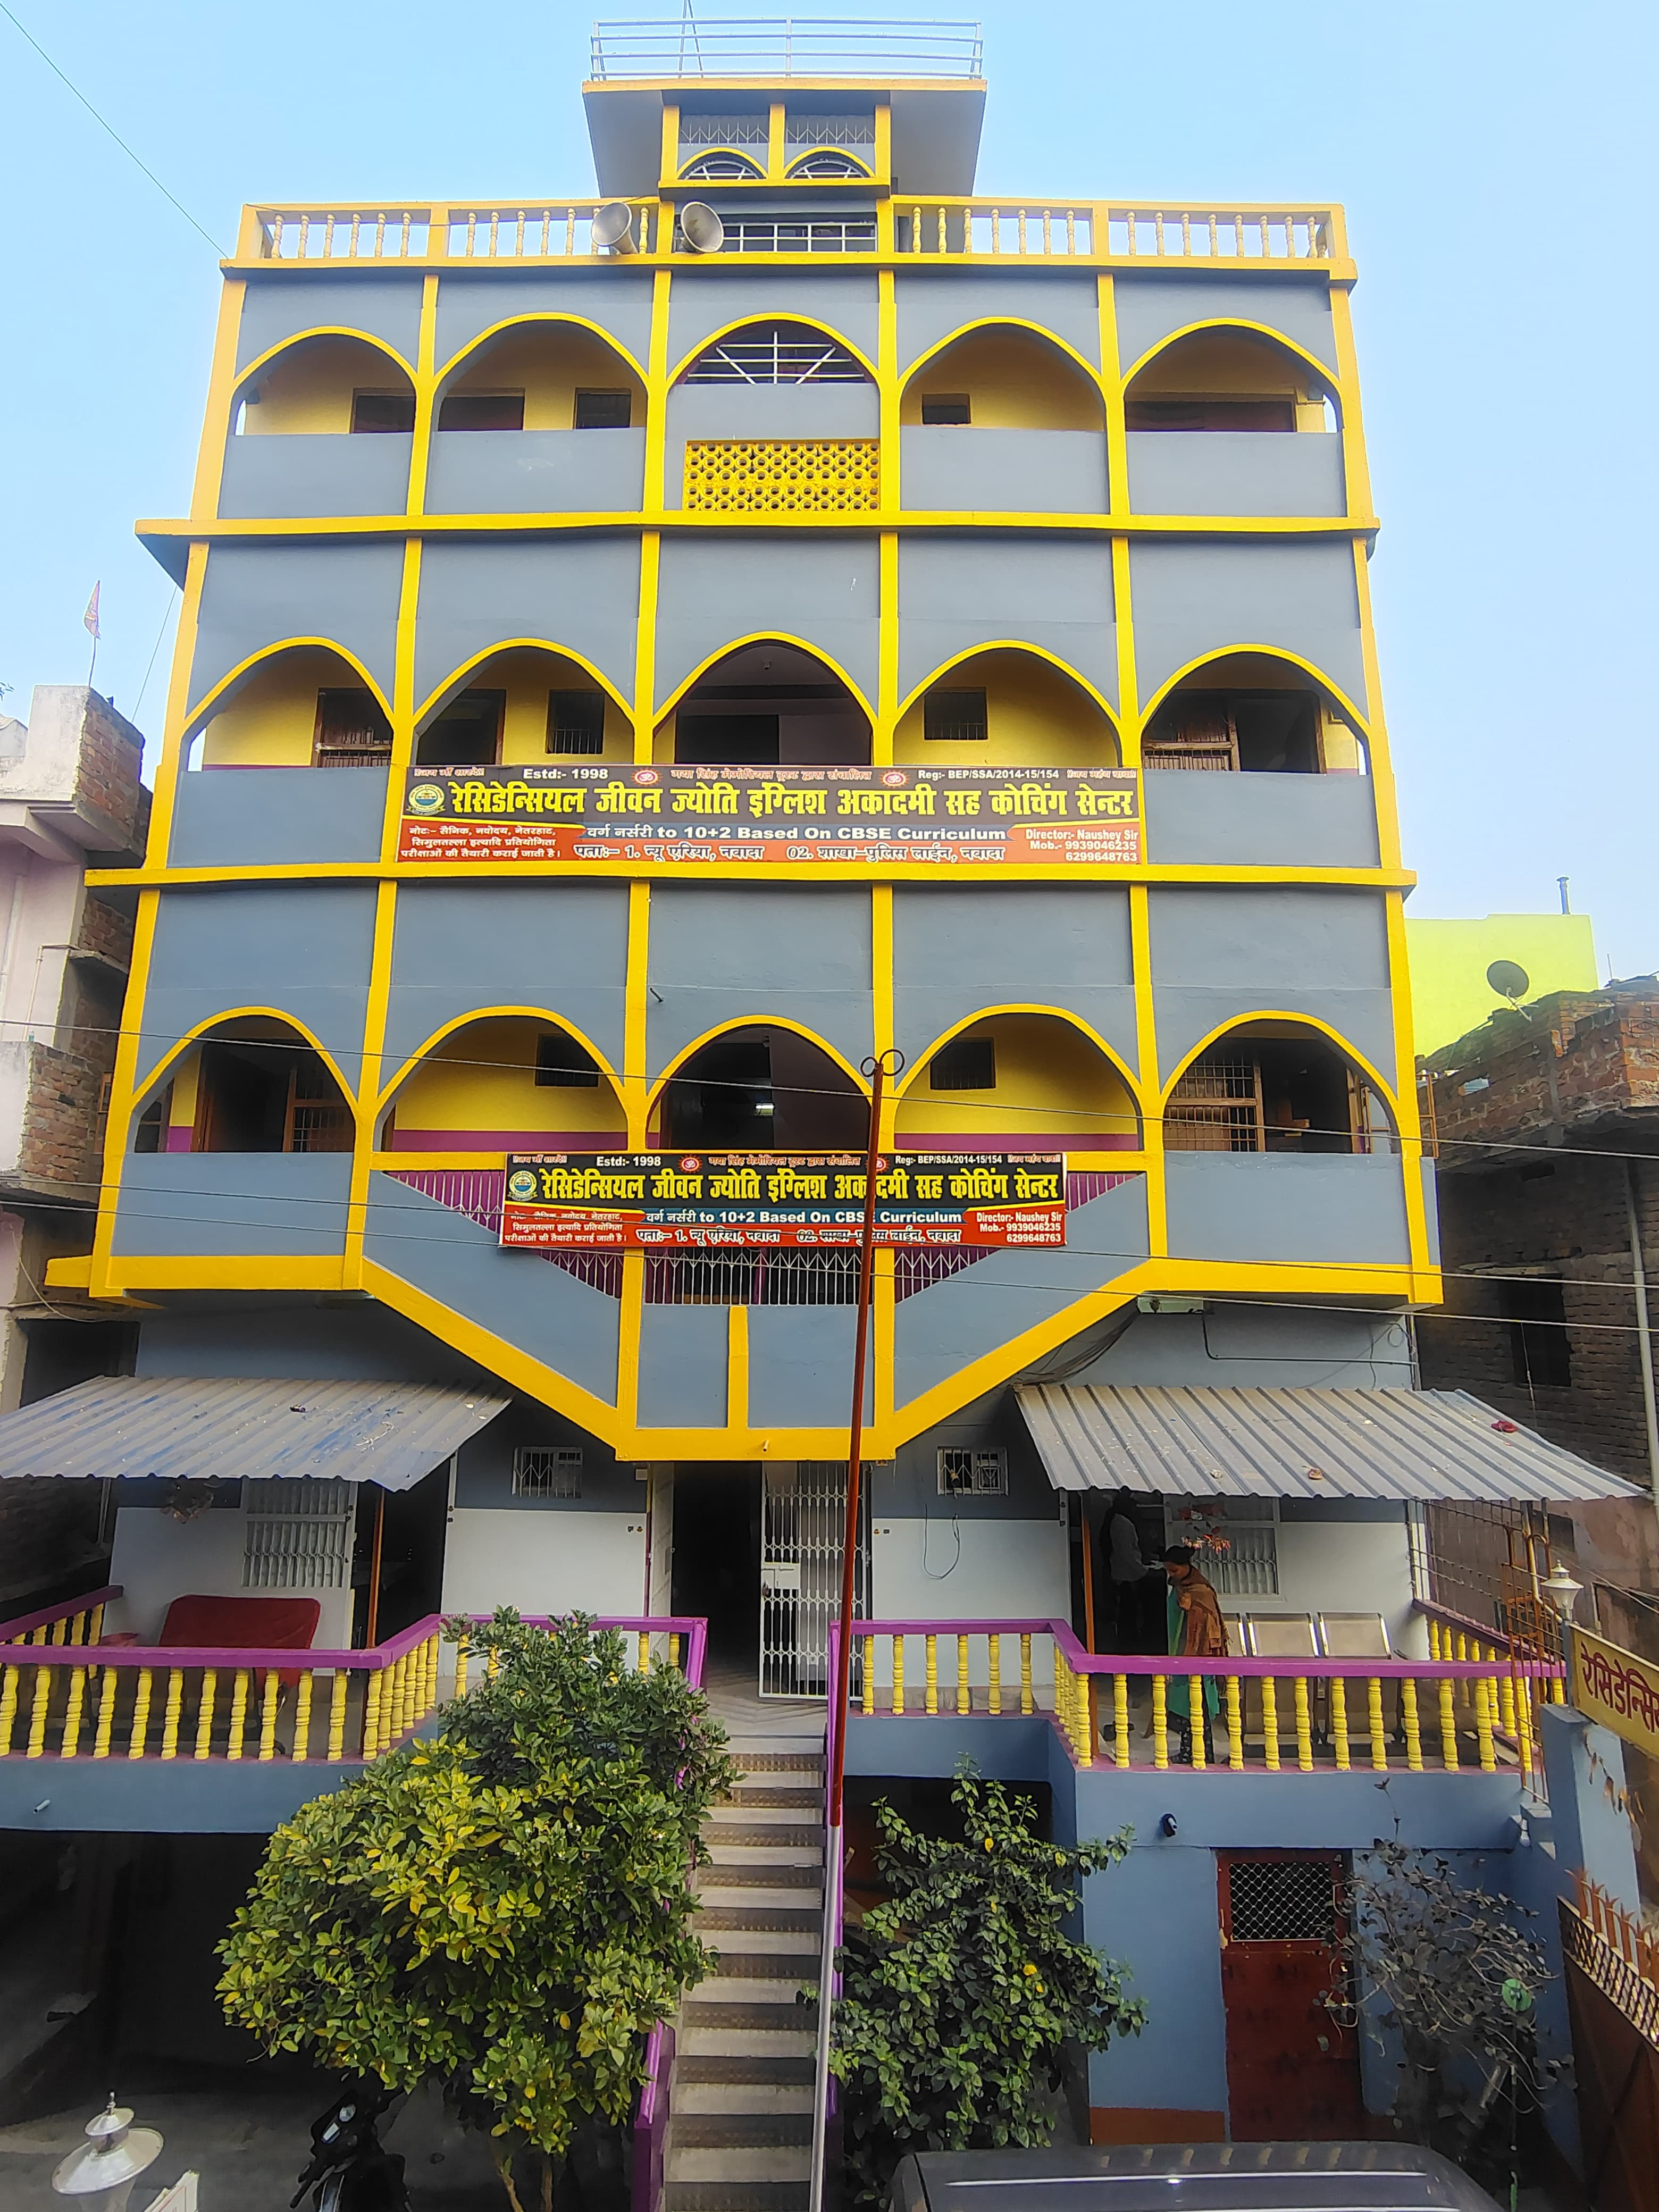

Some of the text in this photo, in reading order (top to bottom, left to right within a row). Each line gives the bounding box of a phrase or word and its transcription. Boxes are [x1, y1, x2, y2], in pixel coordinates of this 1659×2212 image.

[523, 768, 608, 780] Estd:- 1998
[696, 768, 719, 780] सिंह
[720, 768, 774, 780] मेमोरियल
[801, 770, 825, 781] द्वारा
[827, 768, 872, 780] संचालित
[918, 769, 1059, 781] Reg:- BEP/SSA/2014-15/154
[447, 781, 587, 813] रेसिडेन्सियल
[594, 781, 663, 814] जीवन
[670, 782, 740, 814] ज्योति
[837, 783, 937, 815] अकादमी
[944, 790, 982, 816] सह
[988, 782, 1067, 816] कोचिंग
[1075, 783, 1134, 816] सेन्टर
[440, 825, 472, 835] सैनिक,
[475, 825, 511, 835] नवोदय,
[515, 826, 556, 836] नेतरहाट,
[587, 824, 1006, 840] वर्ग नर्सरी to 10+2 Based On CBSE Curriculum
[1026, 829, 1138, 844] Director:- Naushey Sir
[411, 836, 556, 848] सिमुलतल्ला इत्यादि प्रतियोगिता
[1065, 841, 1136, 850] 9939046235
[400, 848, 442, 858] परीक्षाओं
[445, 849, 458, 858] की
[461, 849, 489, 858] तैयारी
[492, 849, 518, 859] कराई
[521, 849, 544, 858] जाती
[625, 846, 640, 858] 1.
[644, 845, 665, 862] न्यू
[667, 841, 716, 862] एरिया,
[719, 845, 765, 859] नवादा
[787, 846, 814, 860] 02.
[960, 847, 1006, 860] नवादा
[1066, 852, 1137, 861] 6299648763
[596, 1156, 661, 1167] Estd:- 1998
[728, 1155, 744, 1166] सिंह
[746, 1154, 786, 1166] मेमोरियल
[807, 1157, 825, 1167] द्वारा
[827, 1155, 861, 1166] संचालित
[895, 1155, 1002, 1166] Reg:- BEP/SSA/2014-15/154
[539, 1168, 645, 1199] रेसिडेन्सियल
[650, 1168, 703, 1199] जीवन
[708, 1168, 761, 1199] ज्योति
[915, 1175, 943, 1200] सह
[948, 1168, 1009, 1200] कोचिंग
[1014, 1168, 1059, 1199] सेन्टर
[647, 1209, 961, 1223] वर्ग नर्सरी to 10+2 Based On CBS Curriculum
[976, 1212, 1062, 1225] Director:- Naushey Sir
[513, 1222, 623, 1233] सिमुलतल्ला इत्यादि प्रतियोगिता
[1006, 1223, 1061, 1232] 9939046235
[505, 1233, 536, 1242] परीक्षाओं
[539, 1234, 549, 1242] की
[551, 1234, 572, 1242] तैयारी
[575, 1234, 594, 1243] कराई
[675, 1230, 688, 1242] 1.
[690, 1229, 706, 1246] न्यू
[747, 1229, 781, 1242] नवादा
[927, 1229, 961, 1242] नवादा
[1007, 1233, 1061, 1243] 6299648763
